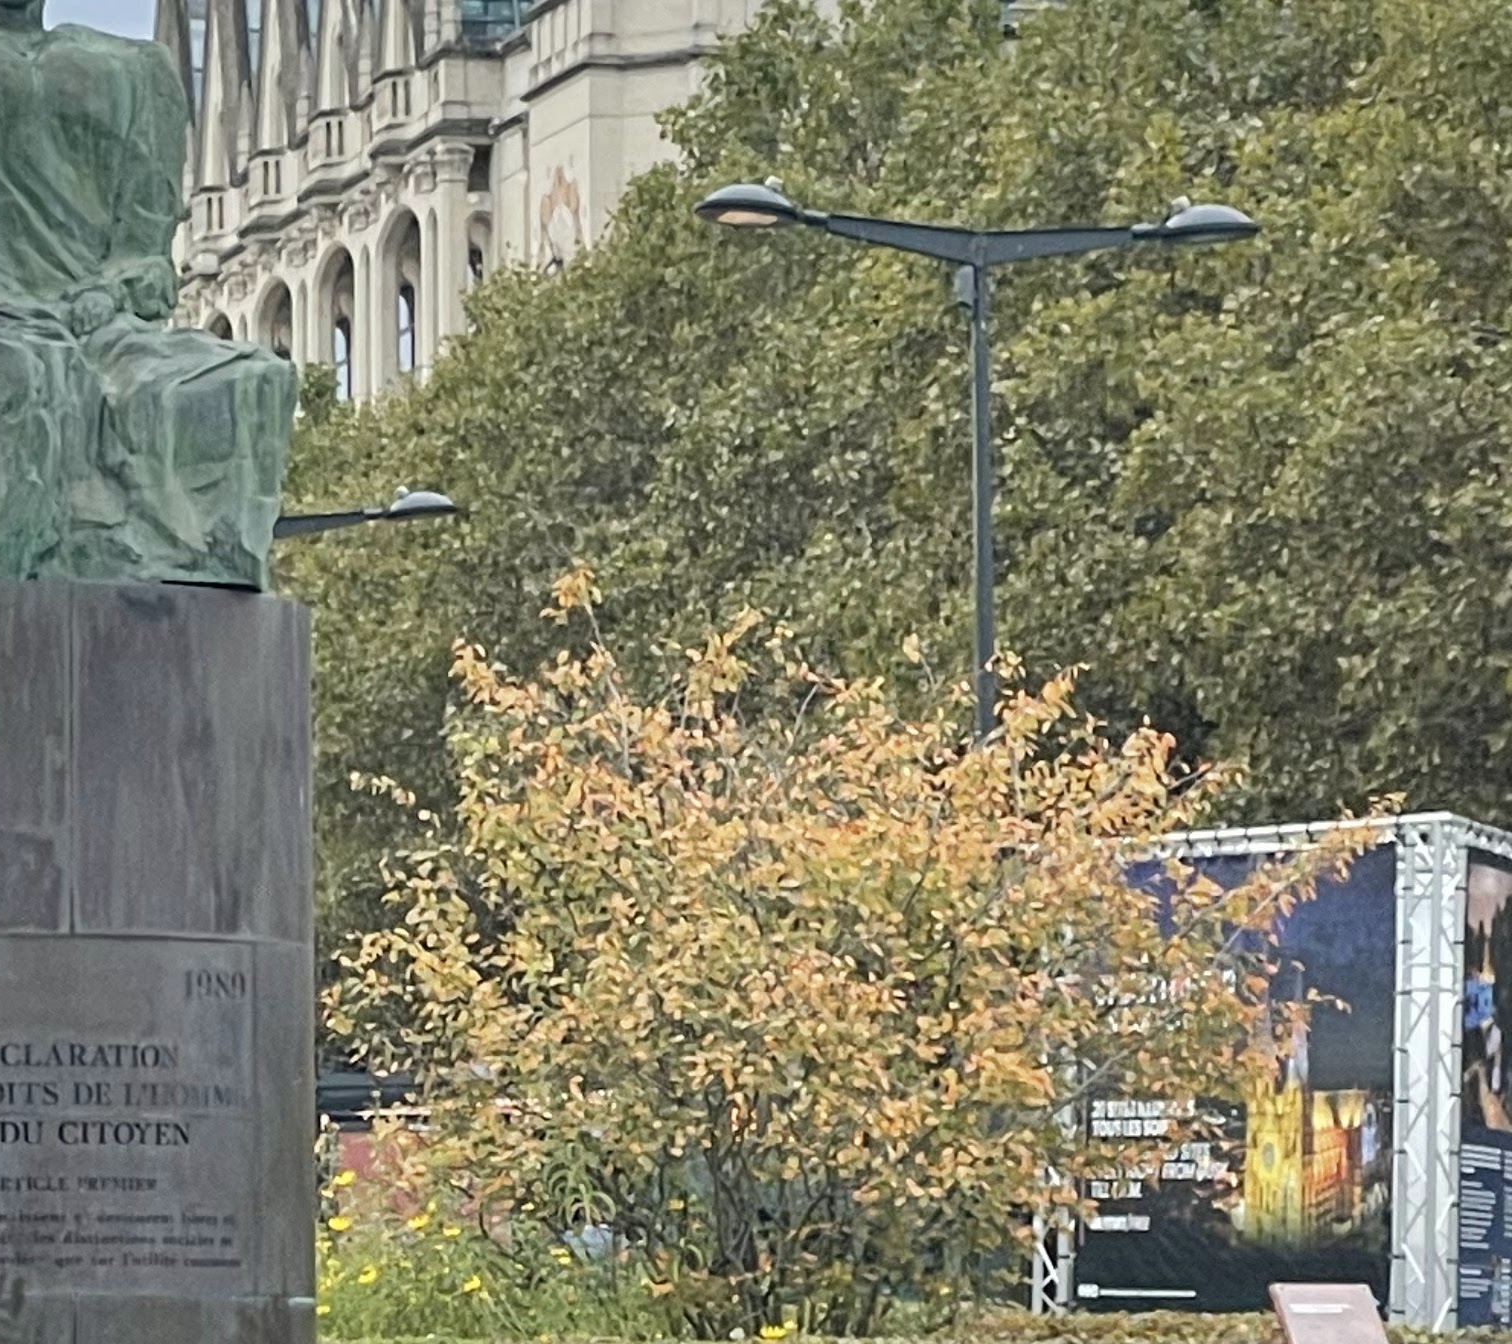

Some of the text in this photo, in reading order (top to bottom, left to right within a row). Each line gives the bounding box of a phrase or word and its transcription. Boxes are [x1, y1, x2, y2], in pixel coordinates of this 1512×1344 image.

[184, 968, 247, 1000] 1989
[72, 1082, 112, 1107] DE
[0, 1121, 44, 1146] DU
[56, 1121, 192, 1147] CITOYEN
